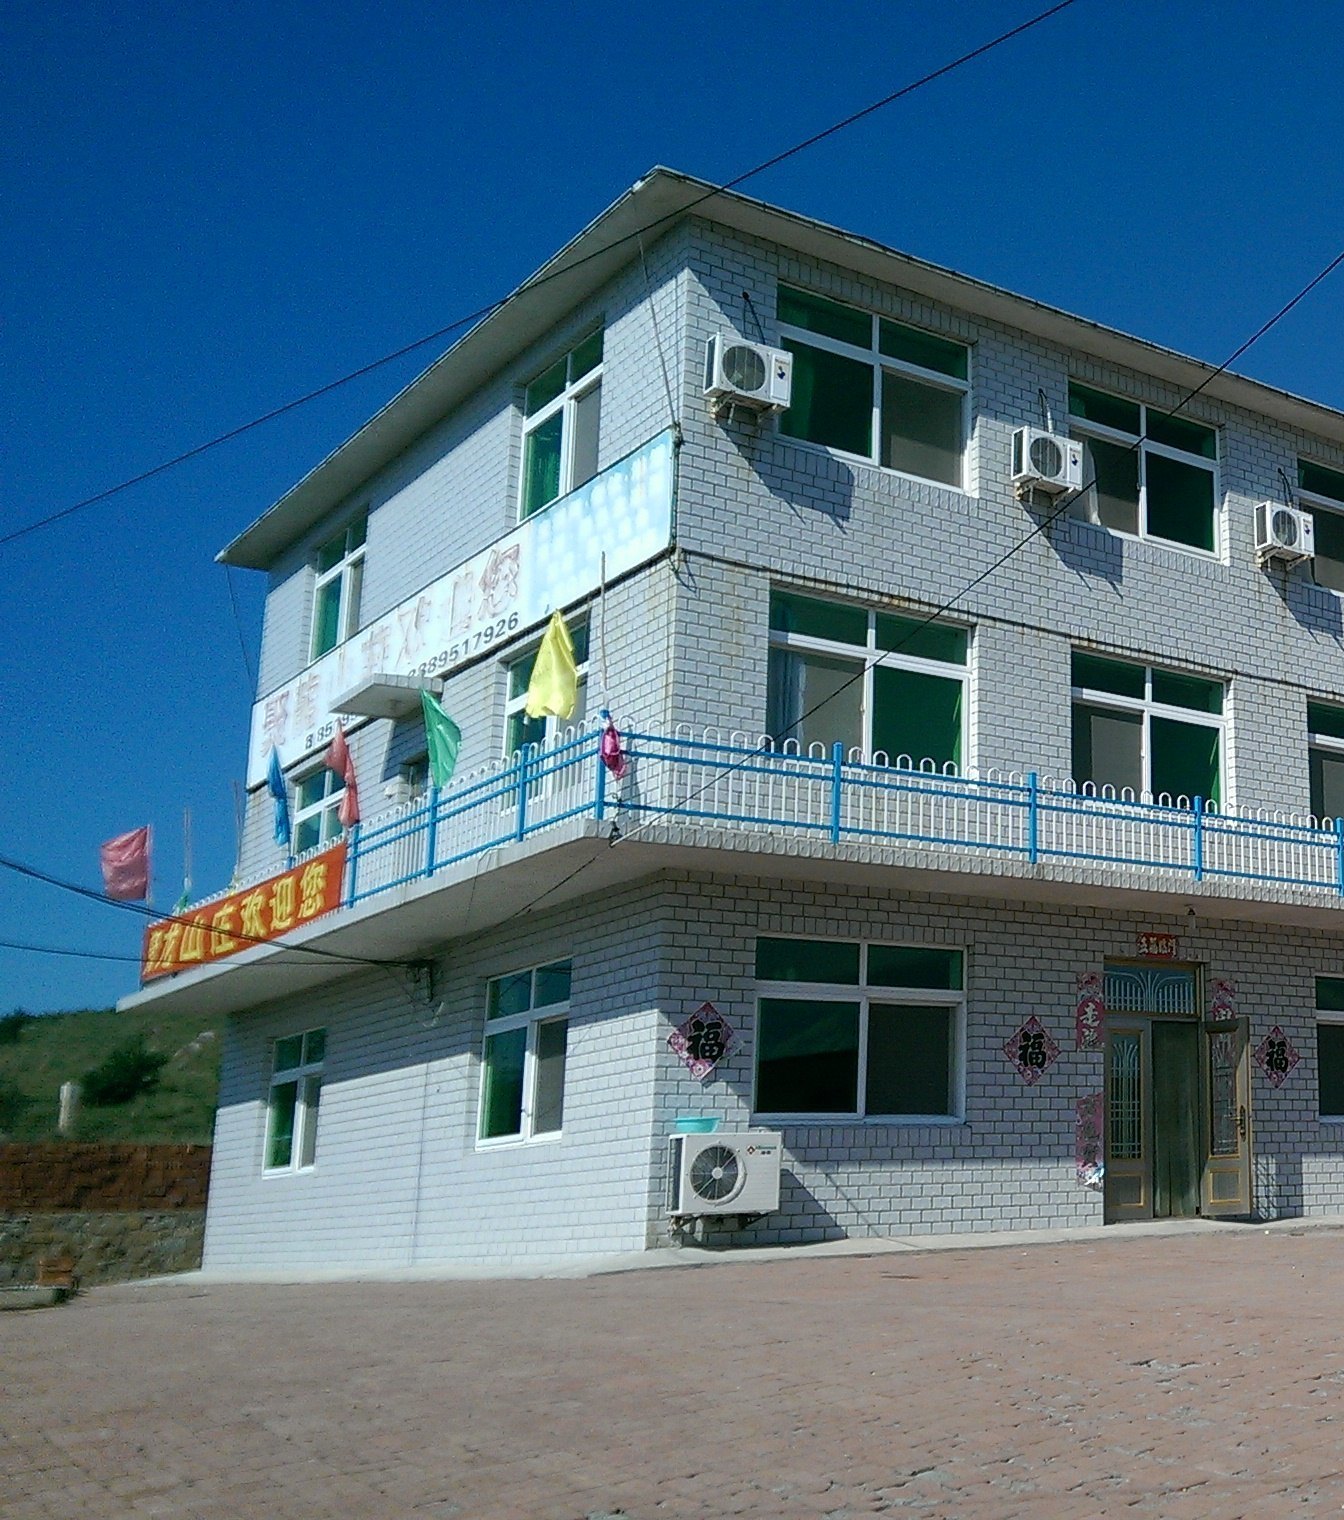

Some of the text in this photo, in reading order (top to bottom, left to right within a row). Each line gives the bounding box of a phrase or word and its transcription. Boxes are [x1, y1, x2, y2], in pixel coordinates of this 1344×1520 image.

[687, 1019, 725, 1060] 福
[1019, 1030, 1048, 1069] 福
[1266, 1040, 1290, 1073] 福
